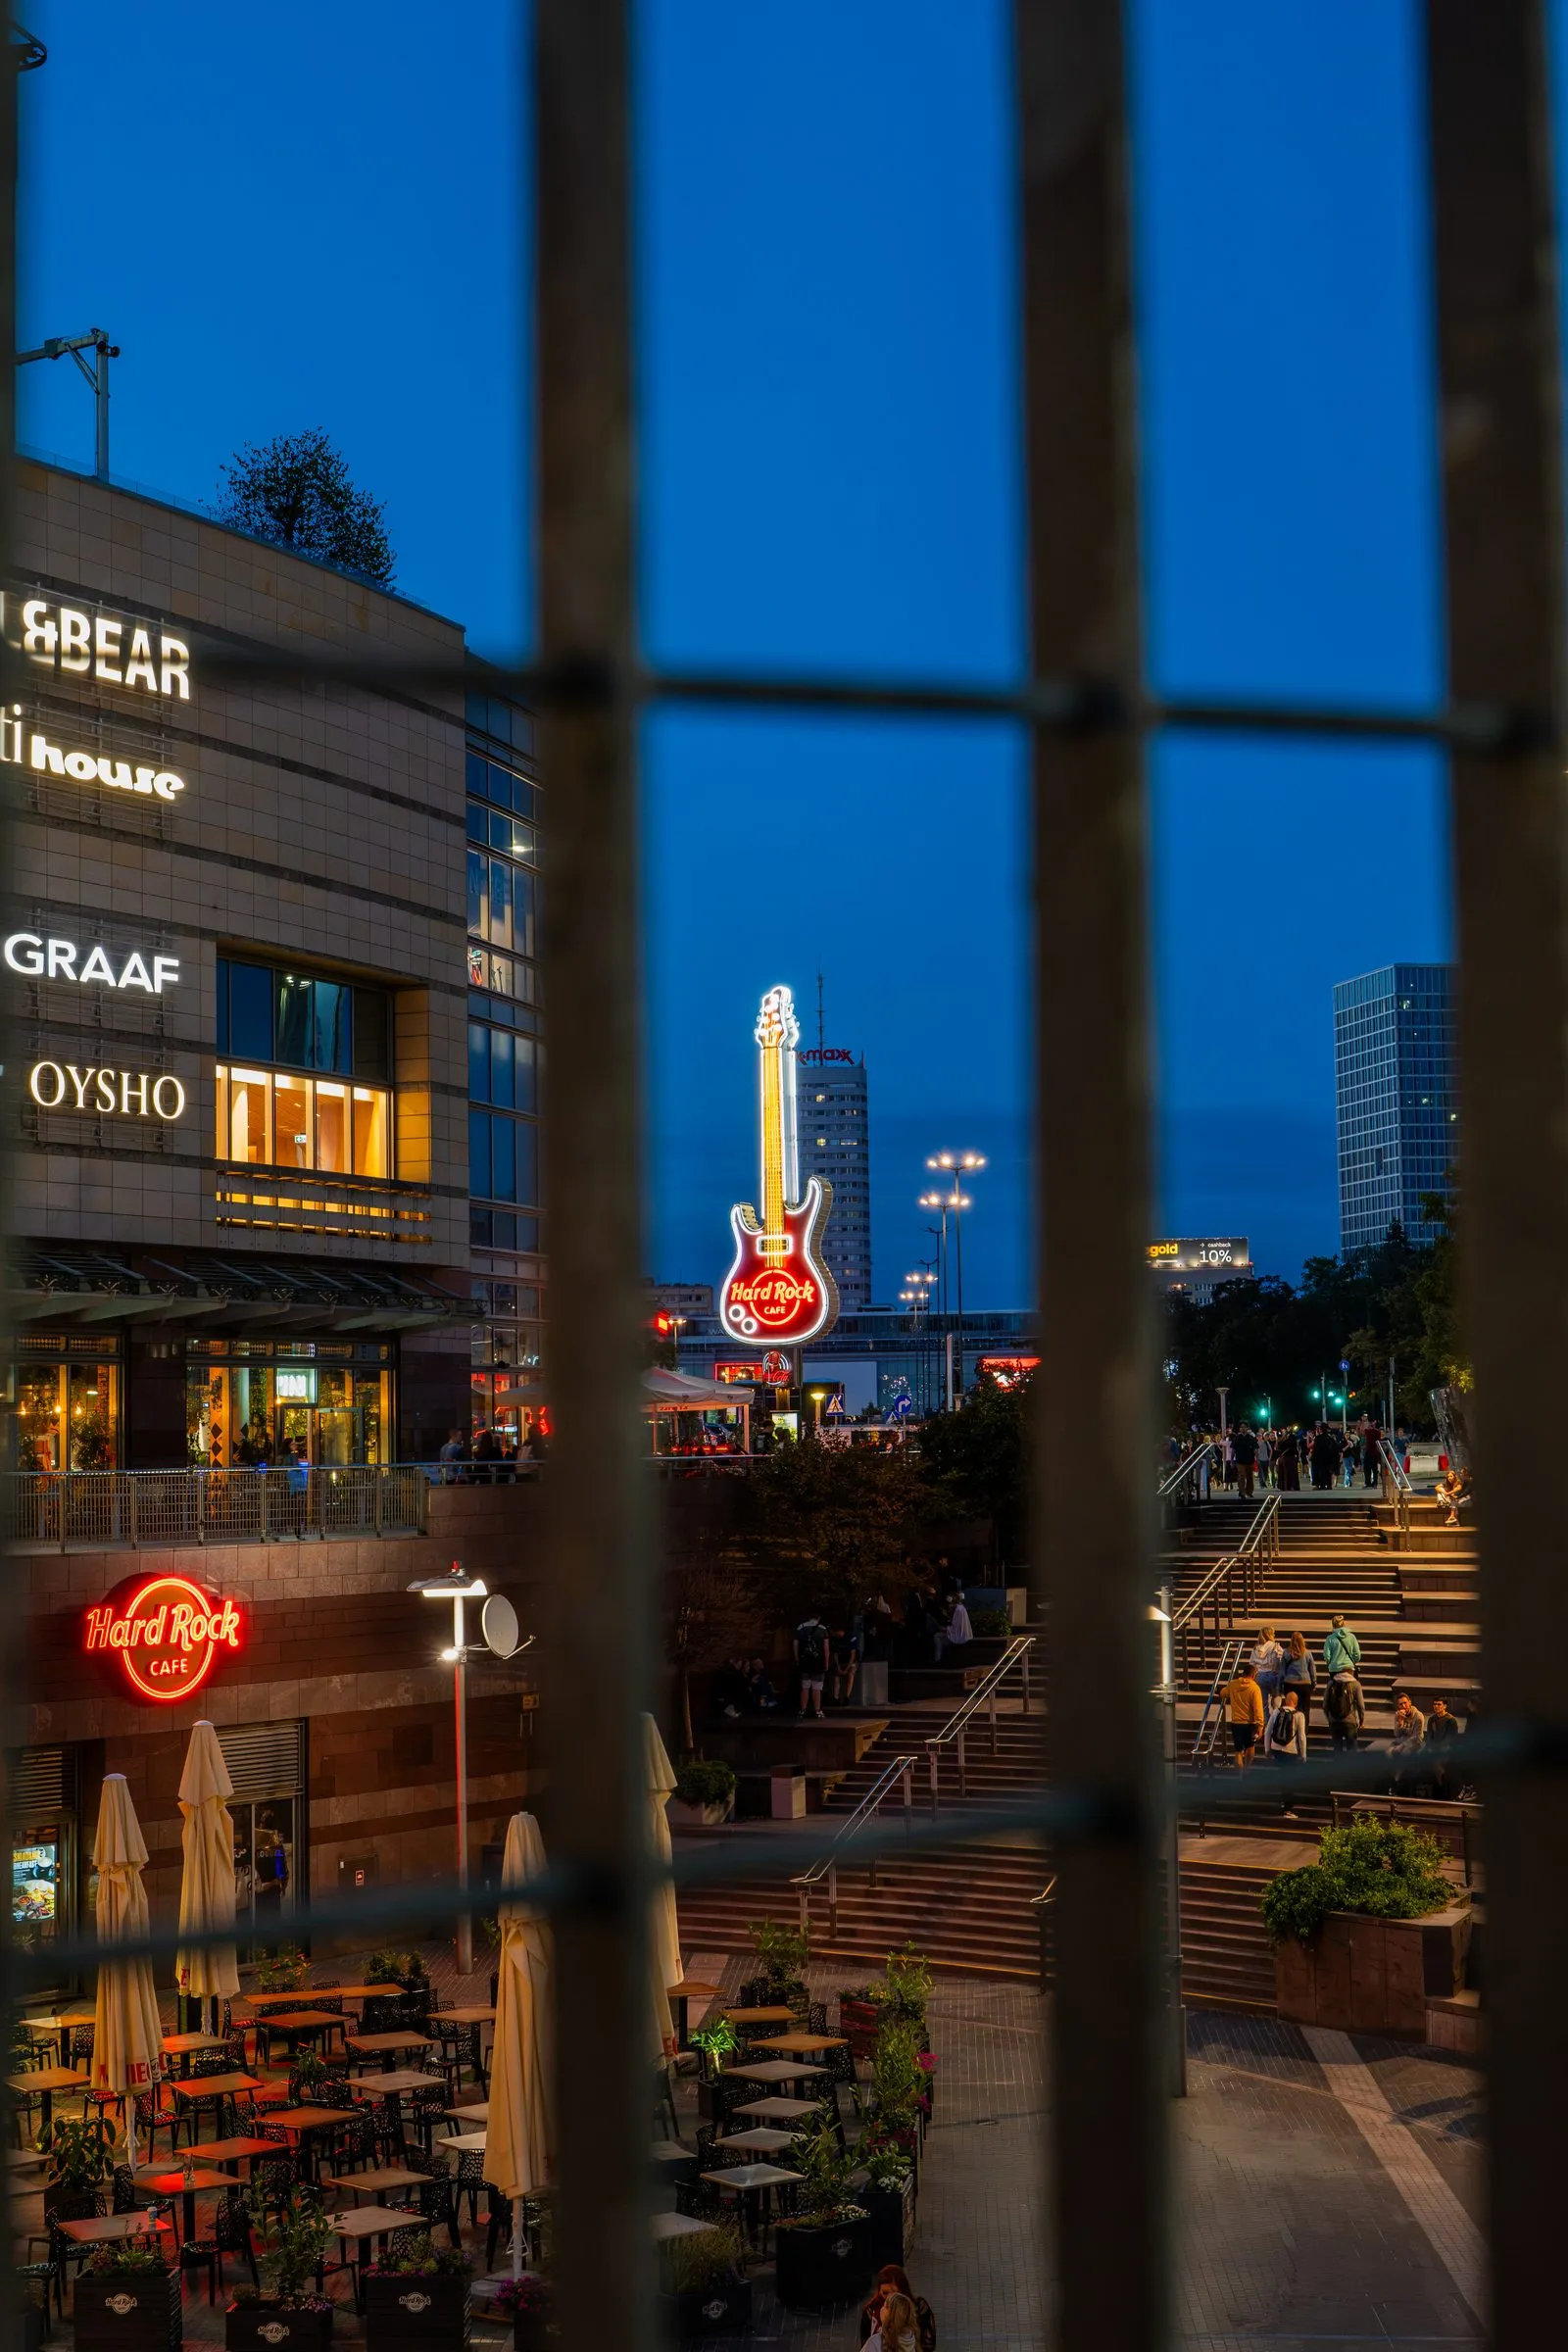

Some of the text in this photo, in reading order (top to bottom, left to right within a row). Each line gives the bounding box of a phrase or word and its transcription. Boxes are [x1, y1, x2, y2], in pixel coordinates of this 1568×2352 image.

[30, 733, 185, 802] house
[3, 932, 179, 994] GRAAF
[30, 1060, 186, 1120] OYSHO
[1199, 1250, 1232, 1263] 10%
[730, 1280, 814, 1303] Hard Rock
[763, 1305, 786, 1315] CAFE
[86, 1600, 240, 1651] Hard Rock
[150, 1658, 189, 1677] CAFE
